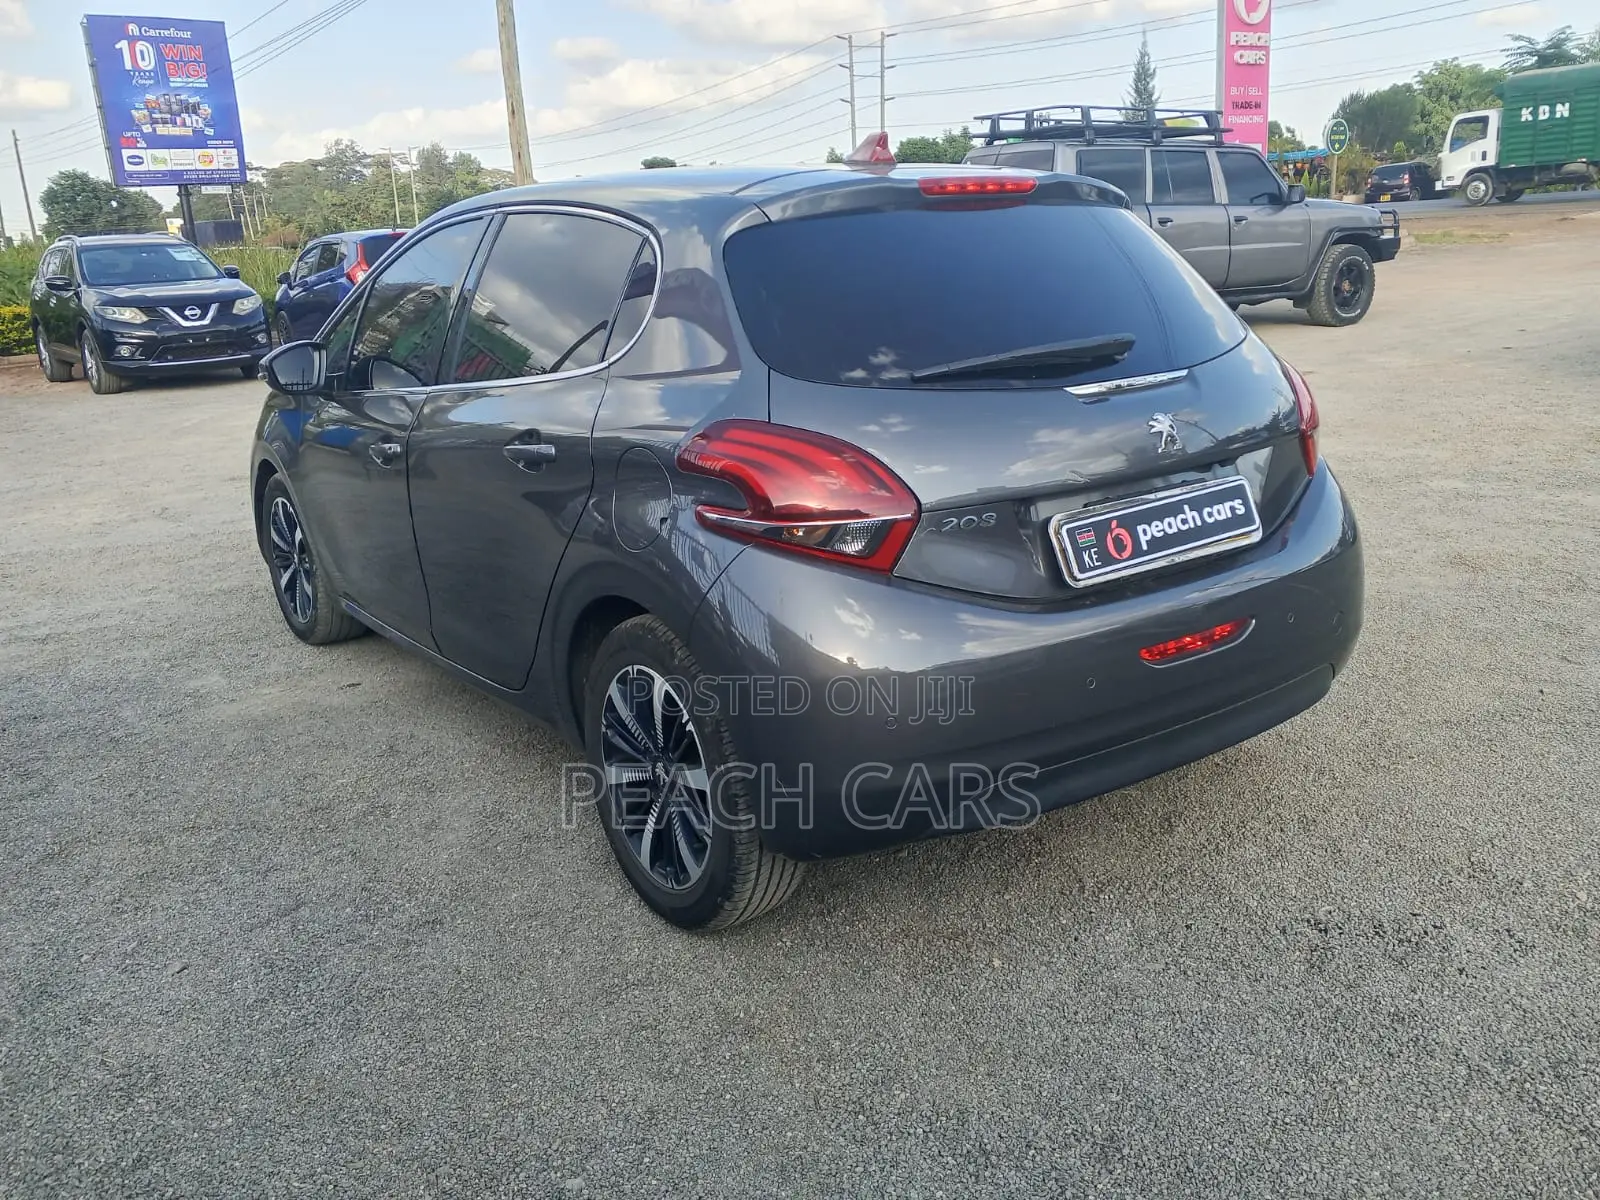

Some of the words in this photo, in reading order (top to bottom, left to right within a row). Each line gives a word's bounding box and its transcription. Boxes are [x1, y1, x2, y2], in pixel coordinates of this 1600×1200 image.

[141, 27, 192, 39] Carrefour
[115, 40, 156, 71] 10
[160, 44, 203, 61] WIN
[1234, 50, 1267, 65] CARS
[166, 62, 208, 79] BIG!
[1230, 86, 1245, 95] BUY
[1248, 86, 1263, 95] SELL
[1232, 101, 1262, 110] TRADE-IN
[1521, 102, 1571, 122] KDN
[1228, 115, 1264, 124] FINANCING
[940, 512, 997, 533] 208
[1137, 504, 1202, 550] peach
[1202, 497, 1246, 523] cars
[1082, 548, 1102, 569] KE
